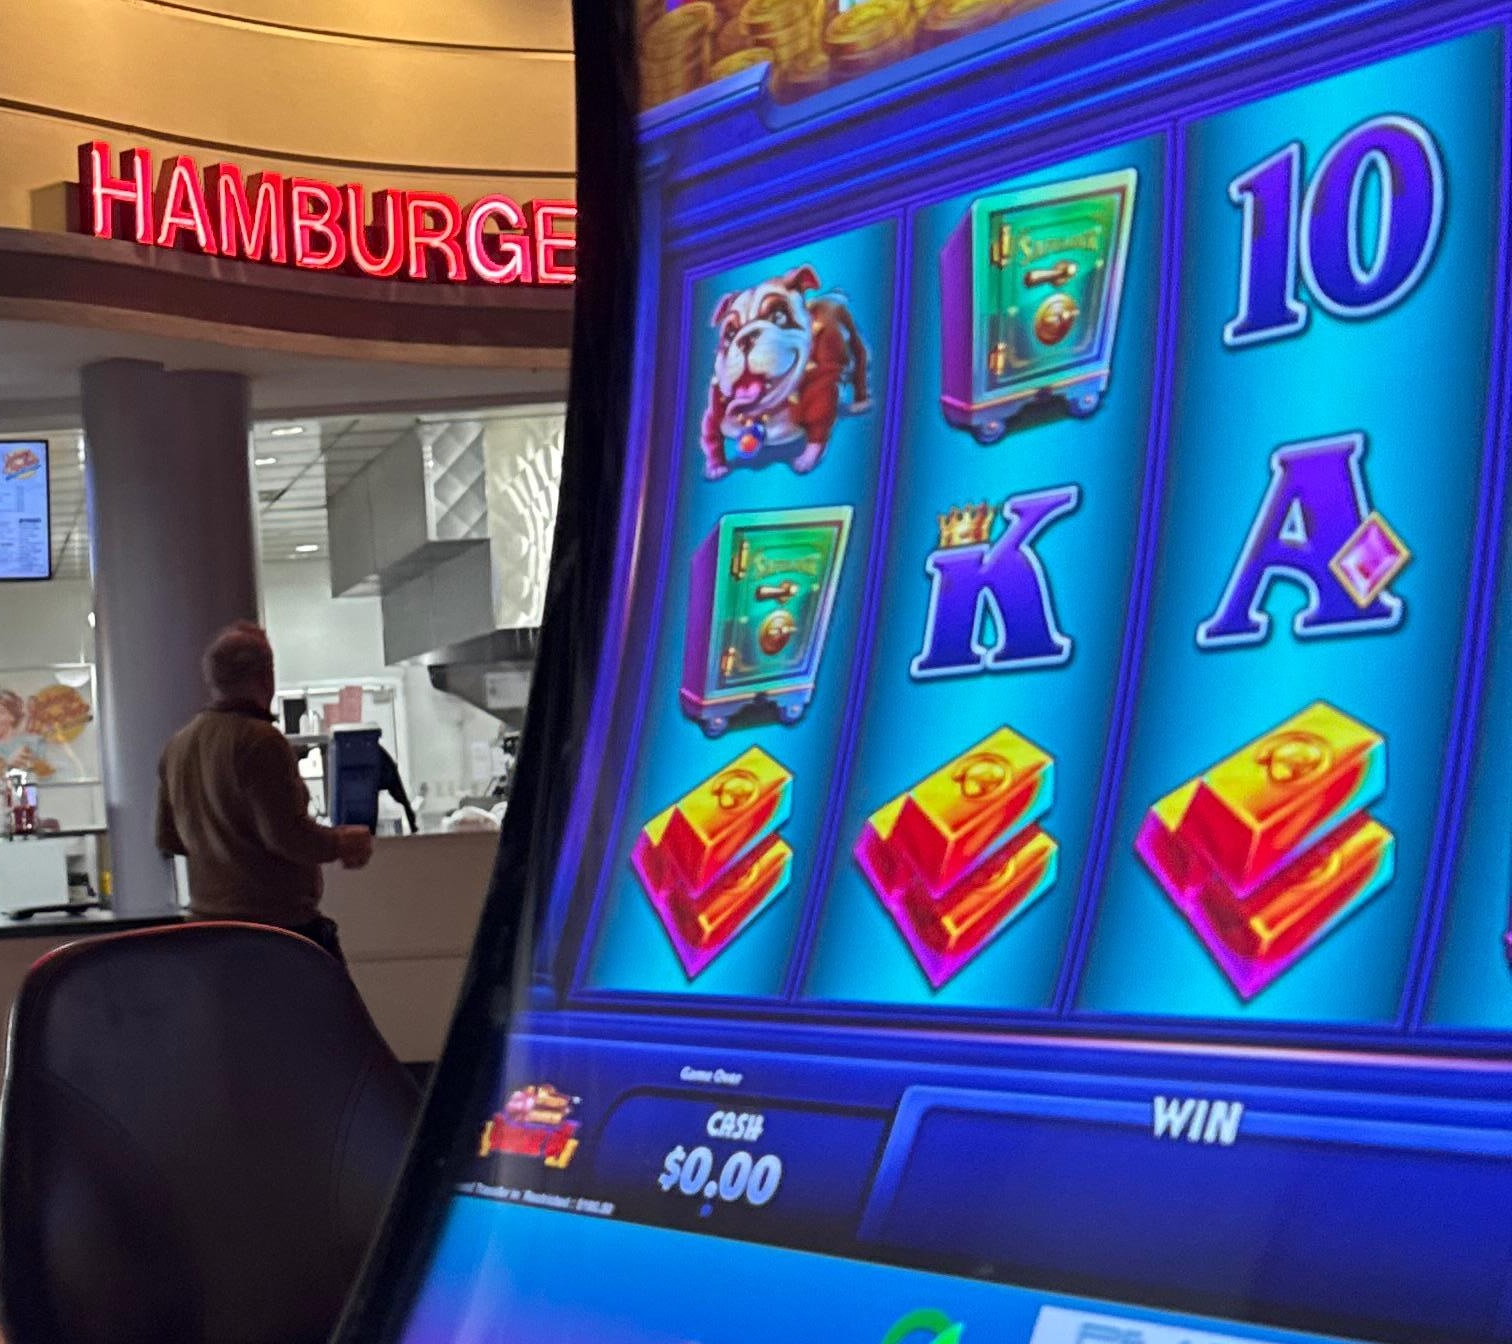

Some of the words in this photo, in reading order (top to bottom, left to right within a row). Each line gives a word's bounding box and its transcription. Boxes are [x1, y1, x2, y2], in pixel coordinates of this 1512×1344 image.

[88, 140, 577, 283] HAMBURGE
[1224, 115, 1448, 345] 10
[909, 484, 1079, 681] K
[1196, 431, 1401, 648] A
[658, 1145, 782, 1205] $0.00
[707, 1110, 764, 1141] CASH
[1152, 1095, 1244, 1147] WIN
